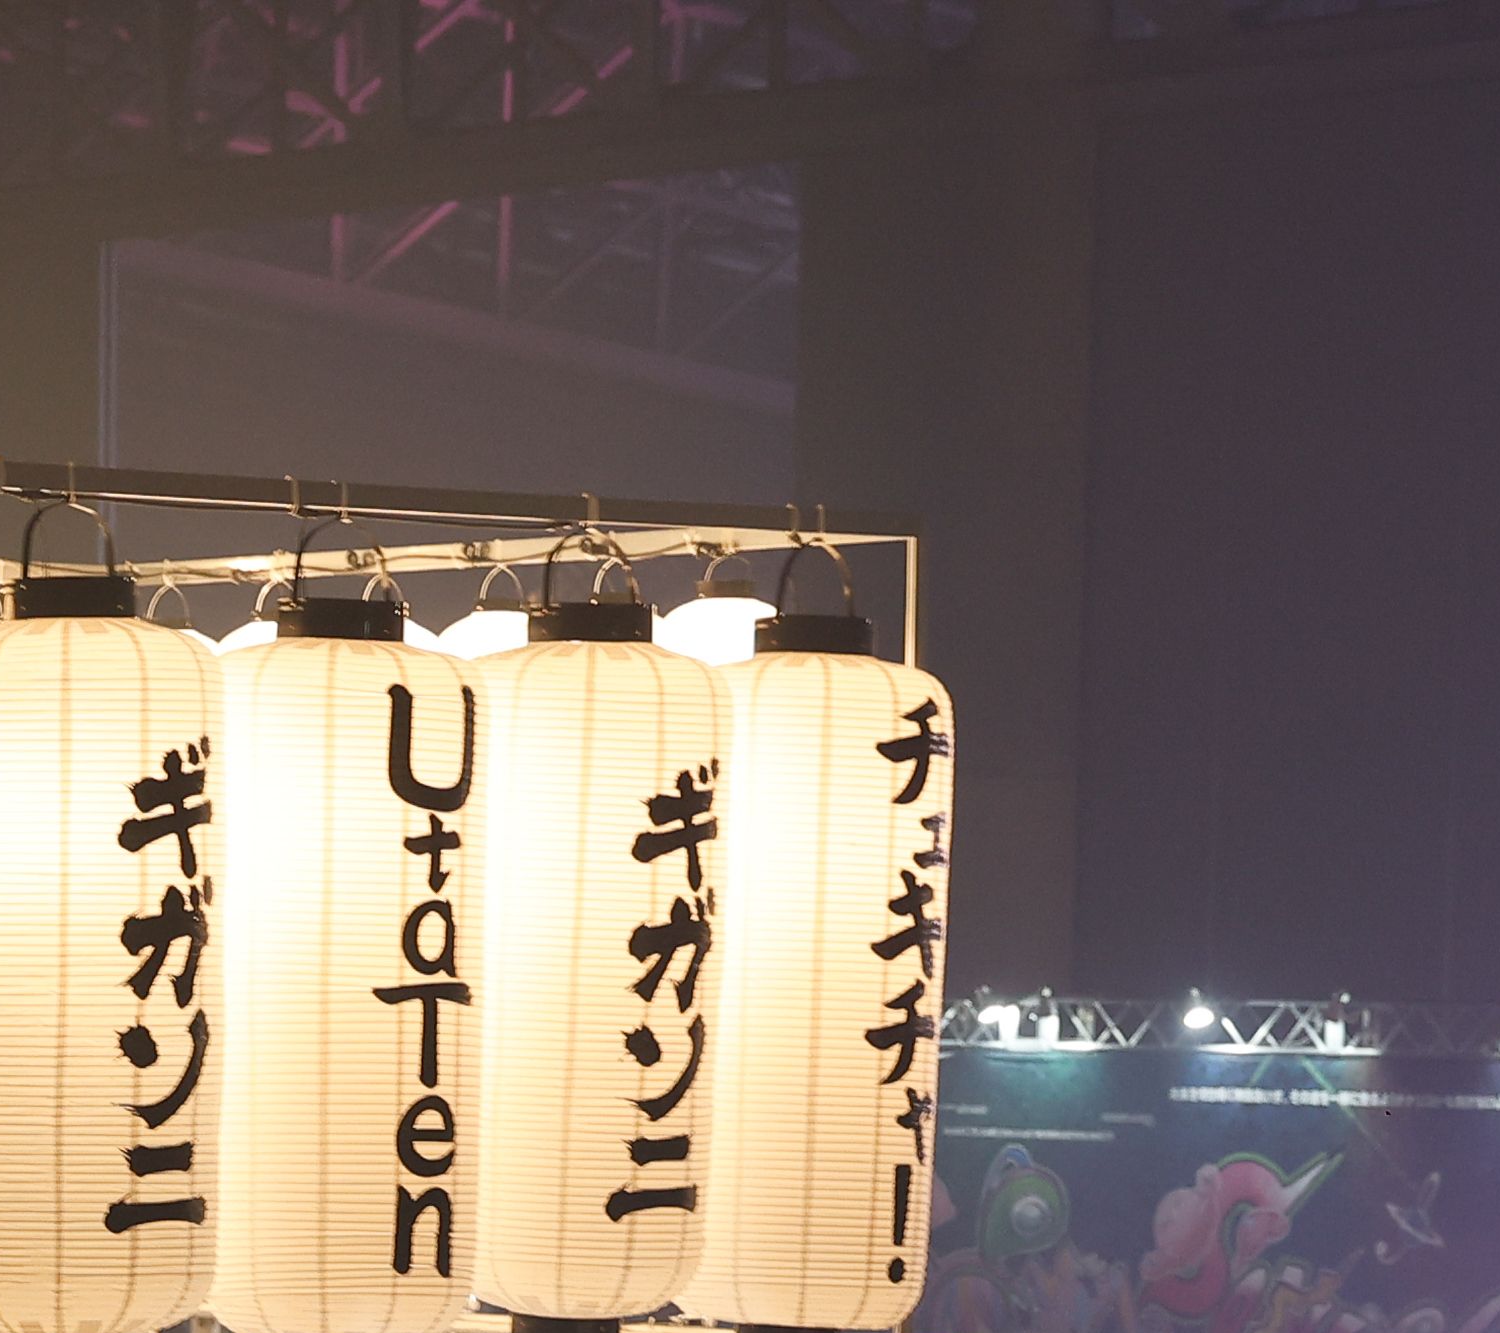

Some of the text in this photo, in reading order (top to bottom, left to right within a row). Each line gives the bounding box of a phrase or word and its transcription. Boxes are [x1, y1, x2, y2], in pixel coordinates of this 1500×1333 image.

[104, 736, 212, 1233] ギガソニ
[372, 684, 475, 1278] UtaTen
[604, 757, 720, 1223] ギガソニ
